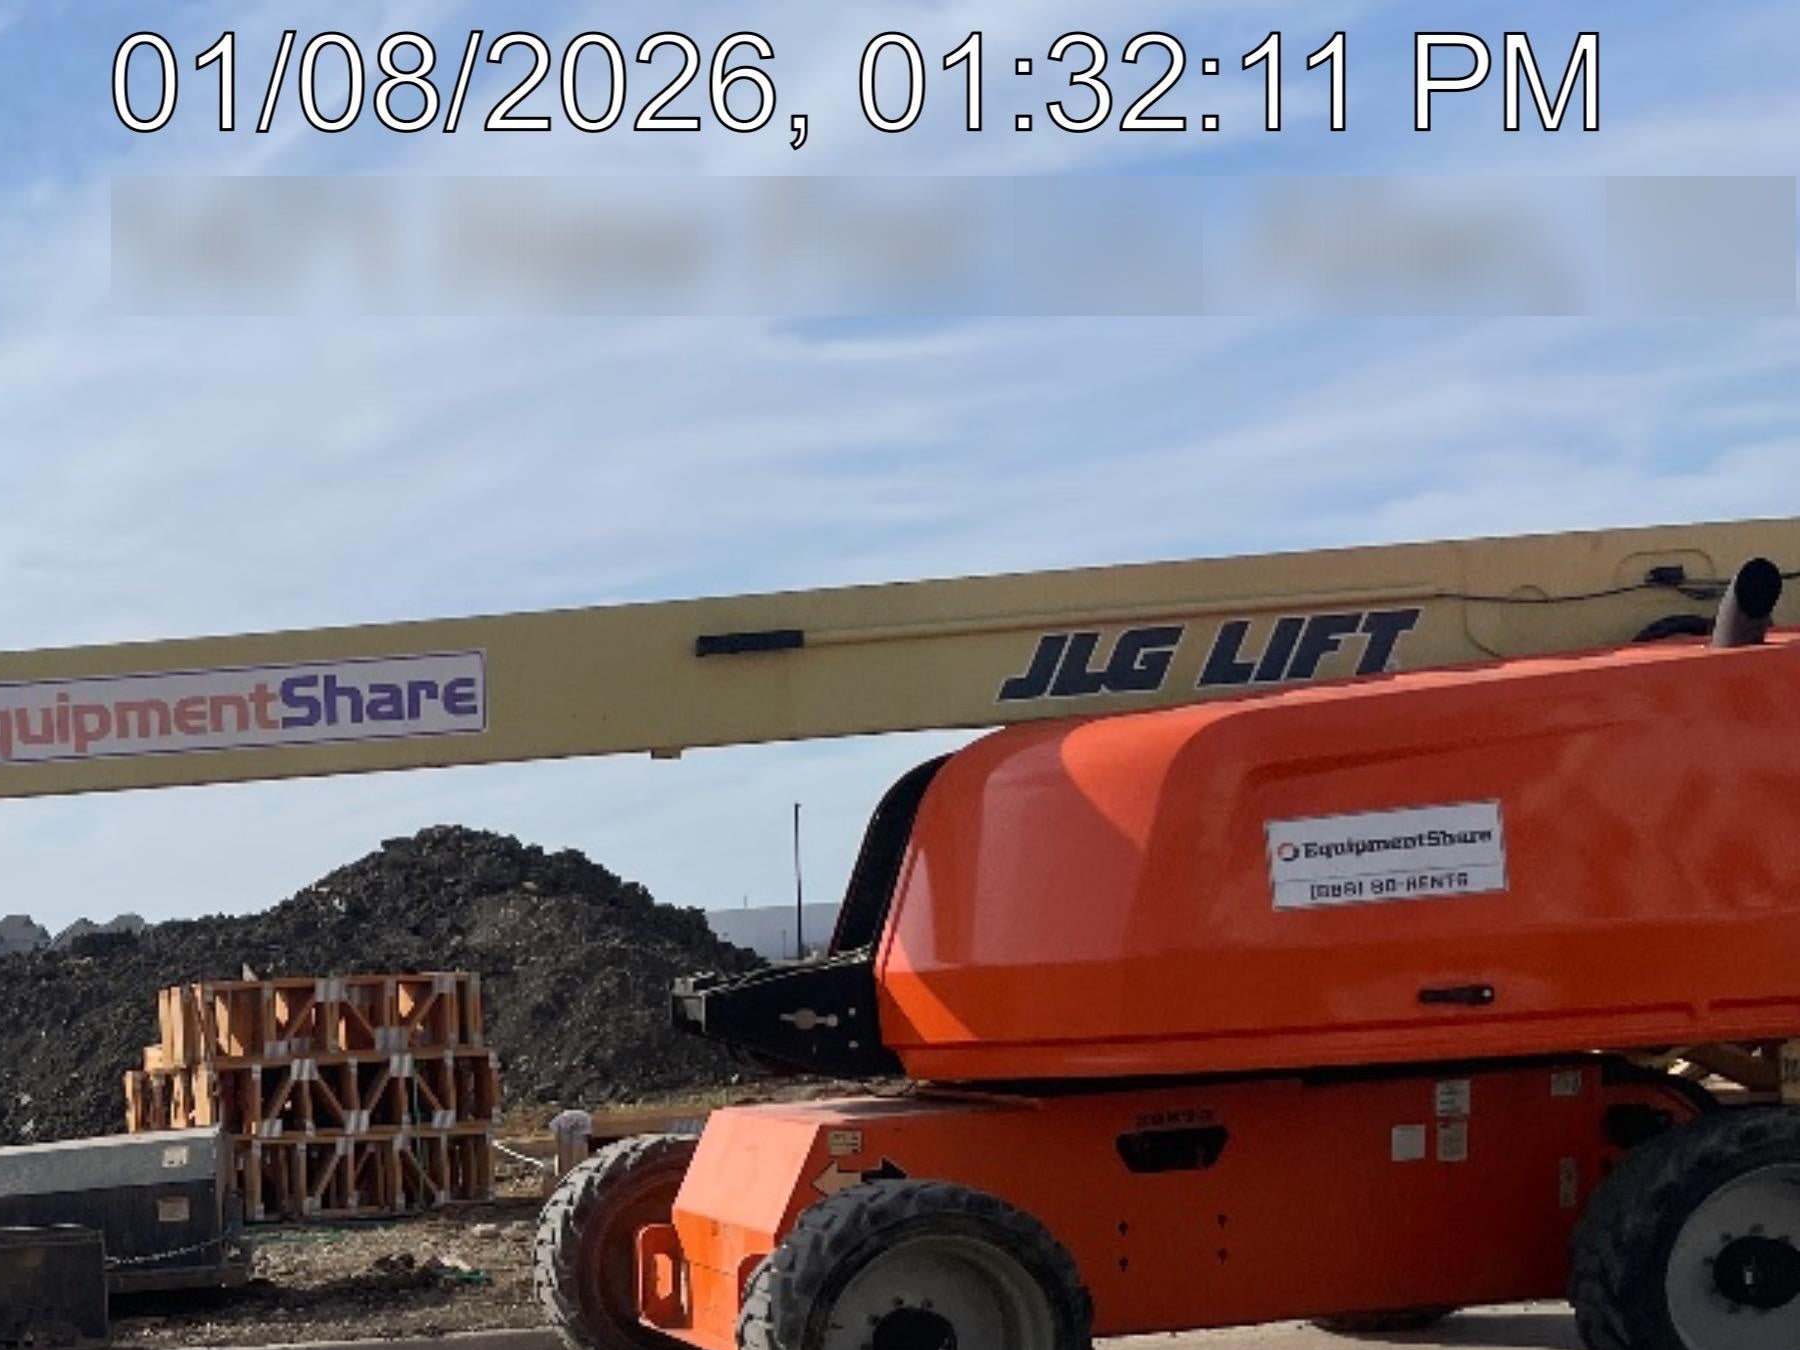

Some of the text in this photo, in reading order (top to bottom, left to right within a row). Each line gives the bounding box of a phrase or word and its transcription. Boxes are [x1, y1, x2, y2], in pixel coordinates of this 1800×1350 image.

[997, 607, 1423, 702] JLG LIFT
[1302, 828, 1493, 861] EquipmentShare
